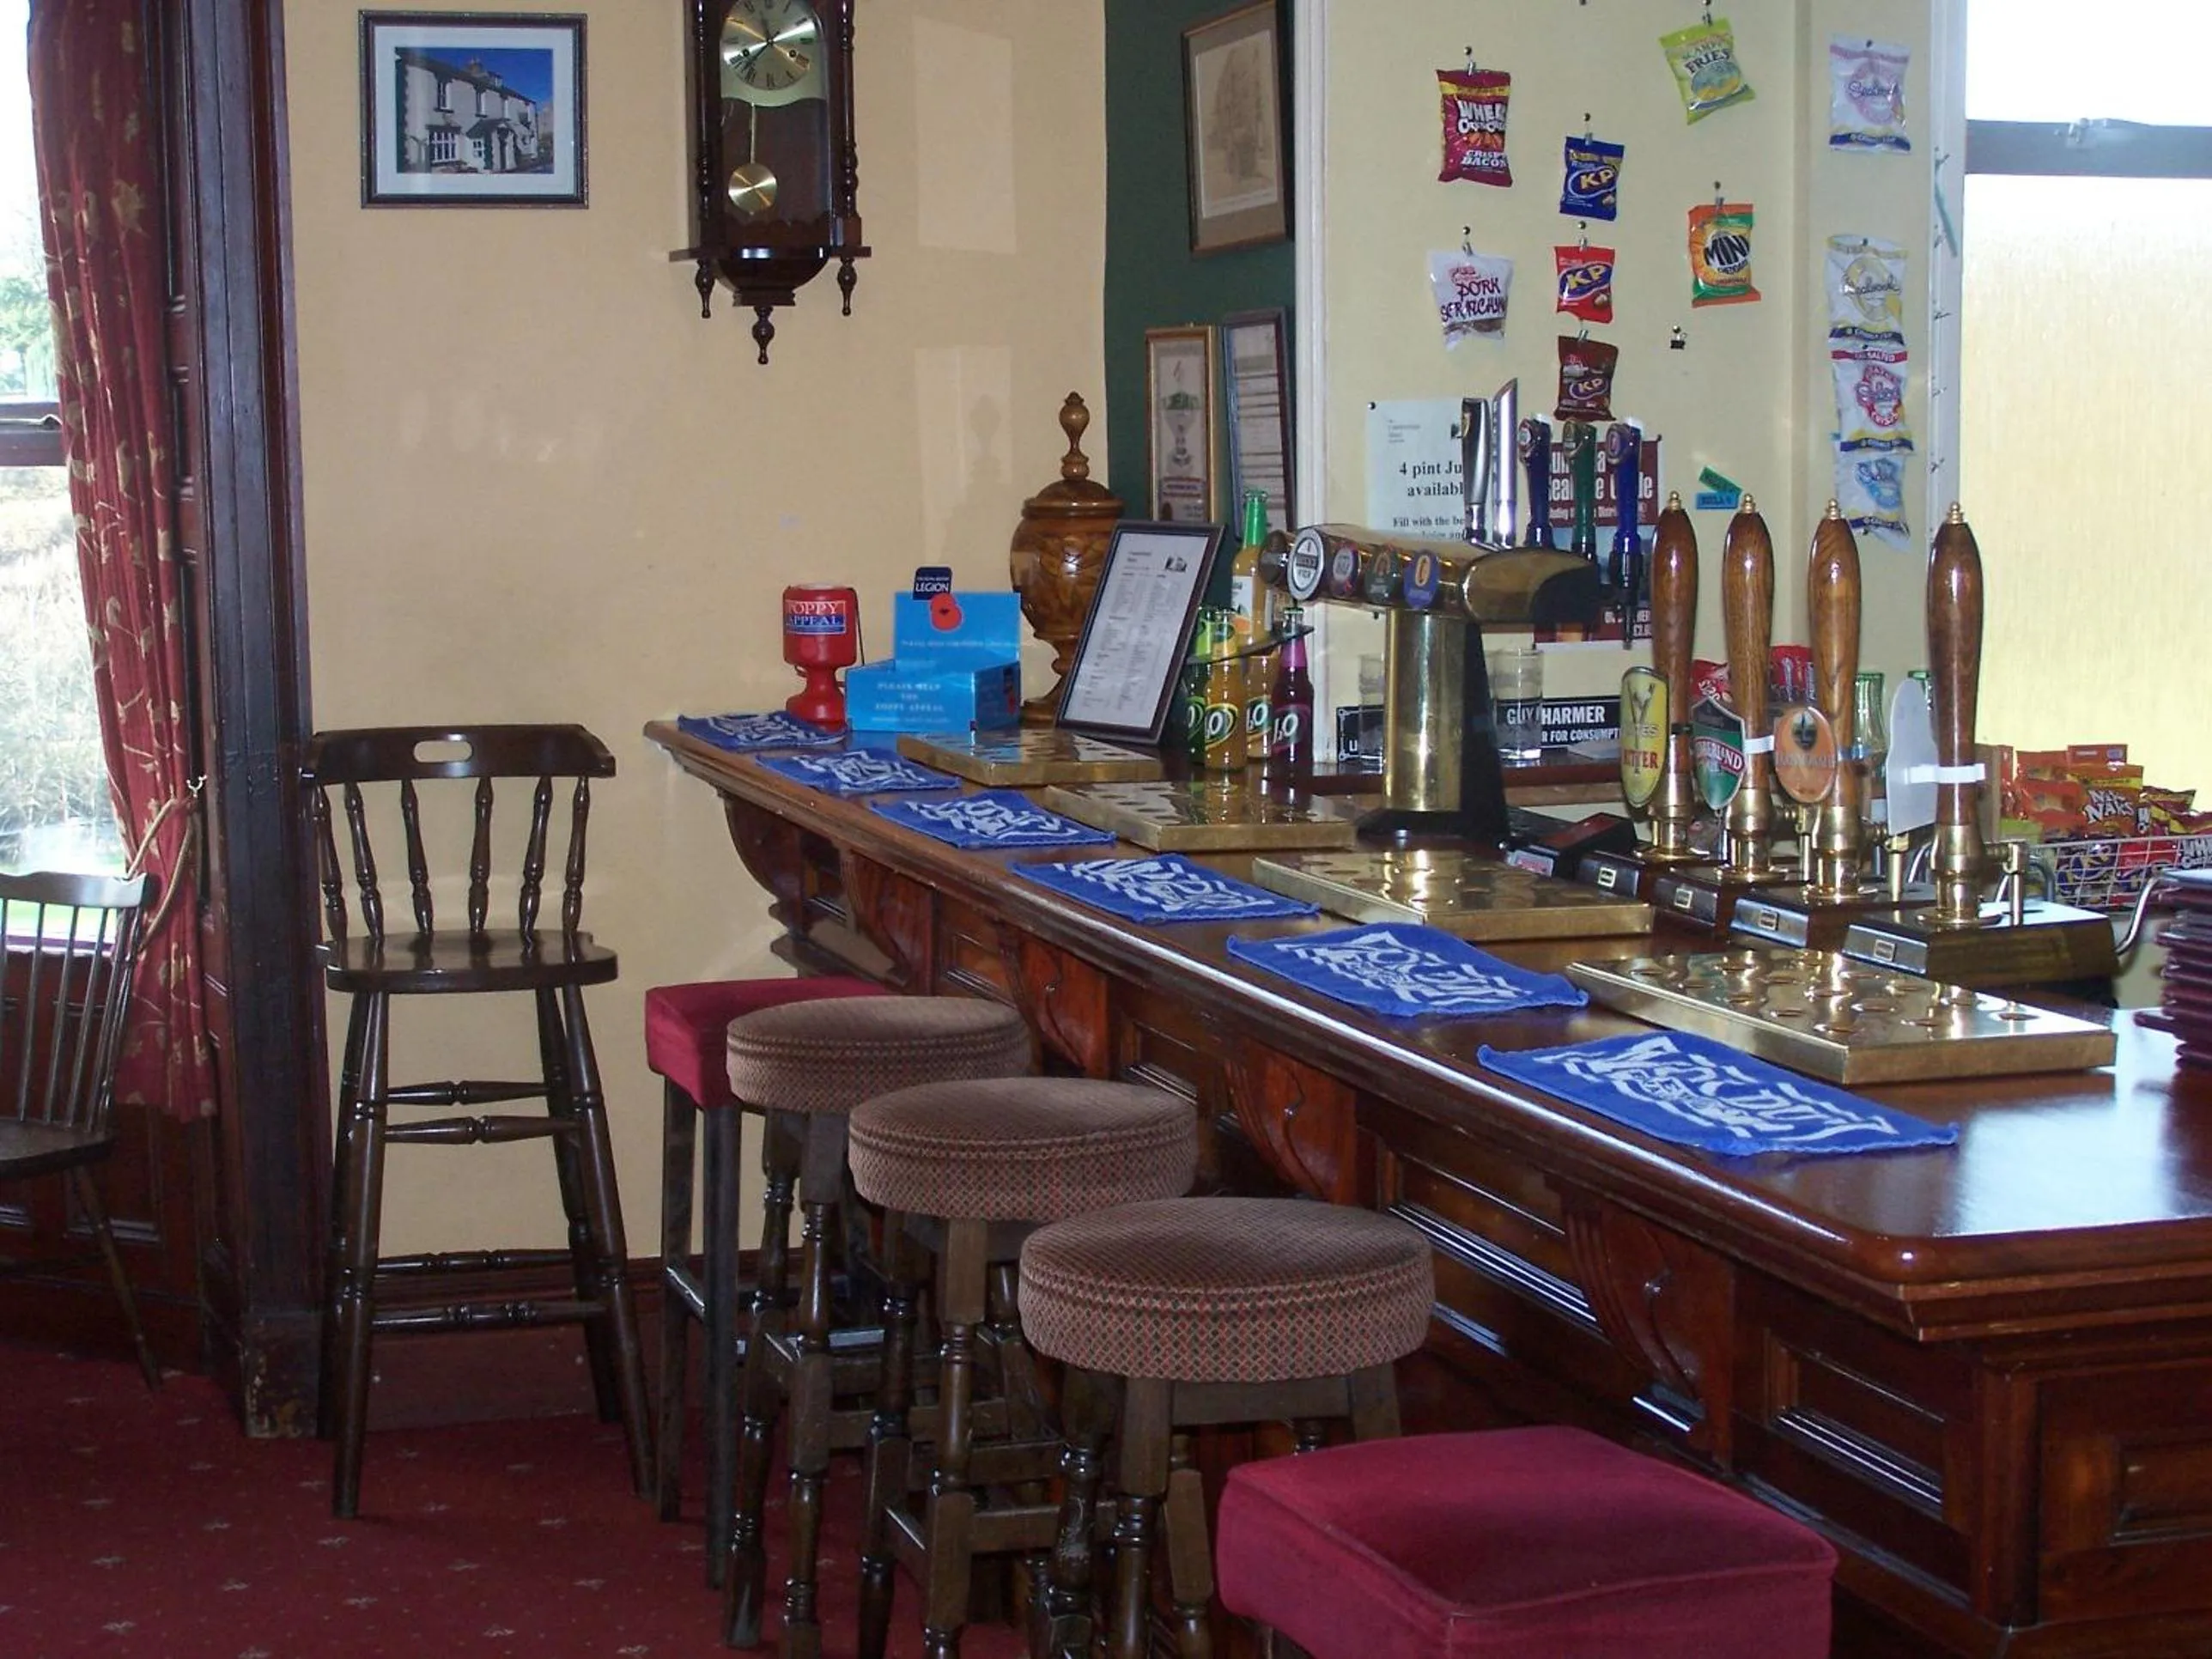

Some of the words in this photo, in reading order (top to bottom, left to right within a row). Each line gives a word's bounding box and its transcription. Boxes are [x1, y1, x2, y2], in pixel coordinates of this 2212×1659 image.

[1685, 48, 1730, 74] FRIES
[1580, 169, 1613, 189] KP
[1566, 264, 1607, 289] KP
[1455, 277, 1501, 301] PORK
[1578, 378, 1604, 394] KP
[1400, 462, 1407, 476] 4
[1413, 461, 1441, 479] pint
[1444, 460, 1462, 474] Ju
[1407, 482, 1464, 497] availabl
[1393, 517, 1409, 527] Fill
[1542, 706, 1606, 725] HARMER
[1550, 730, 1568, 742] FOR
[1571, 728, 1619, 742] CONSUMPT
